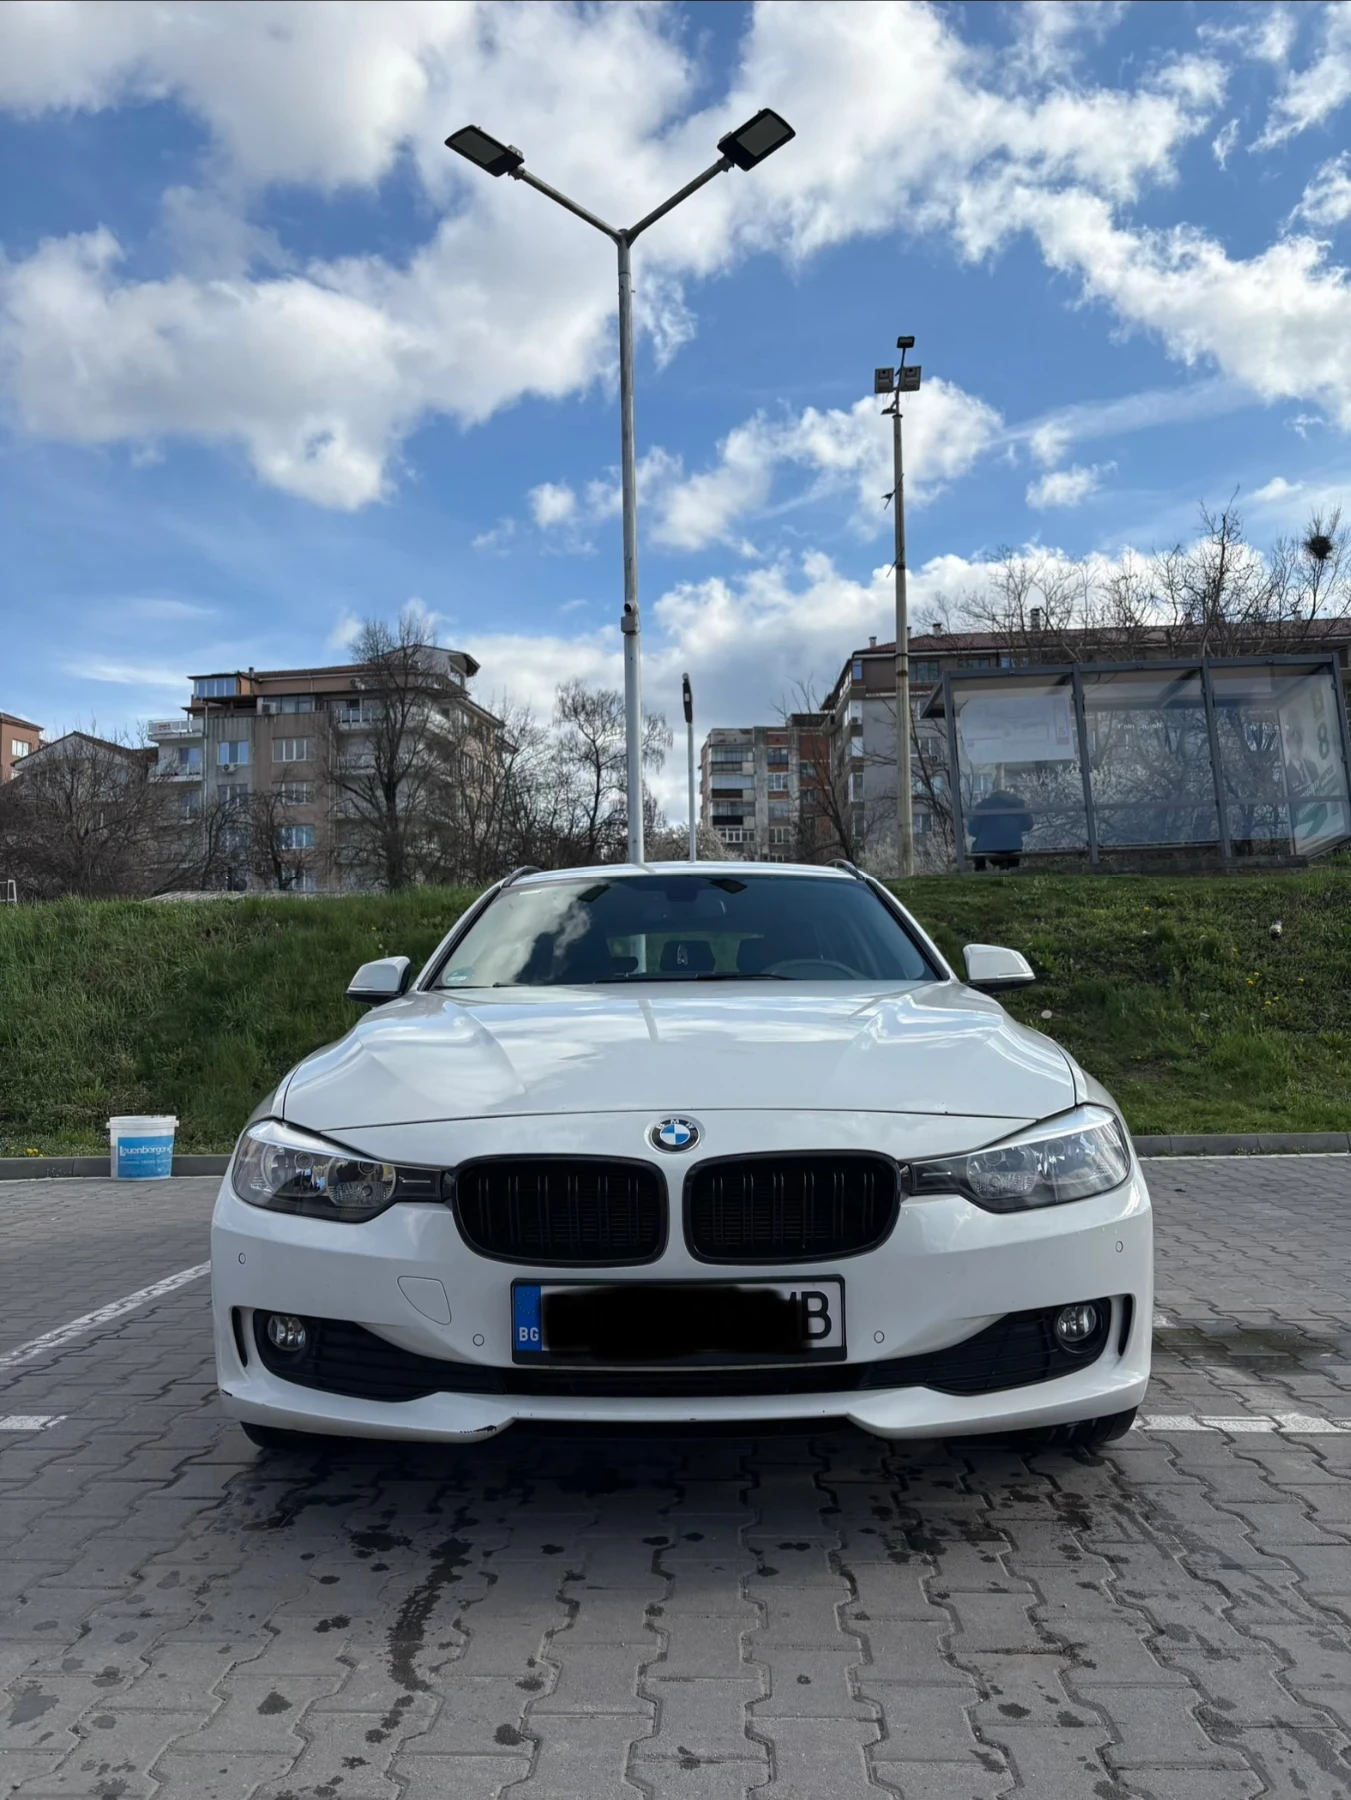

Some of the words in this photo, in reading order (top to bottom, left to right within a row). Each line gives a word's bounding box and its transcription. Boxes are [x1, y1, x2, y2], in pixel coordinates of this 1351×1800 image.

[656, 1119, 695, 1130] BMW
[789, 1291, 832, 1340] B
[519, 1327, 539, 1341] BG
